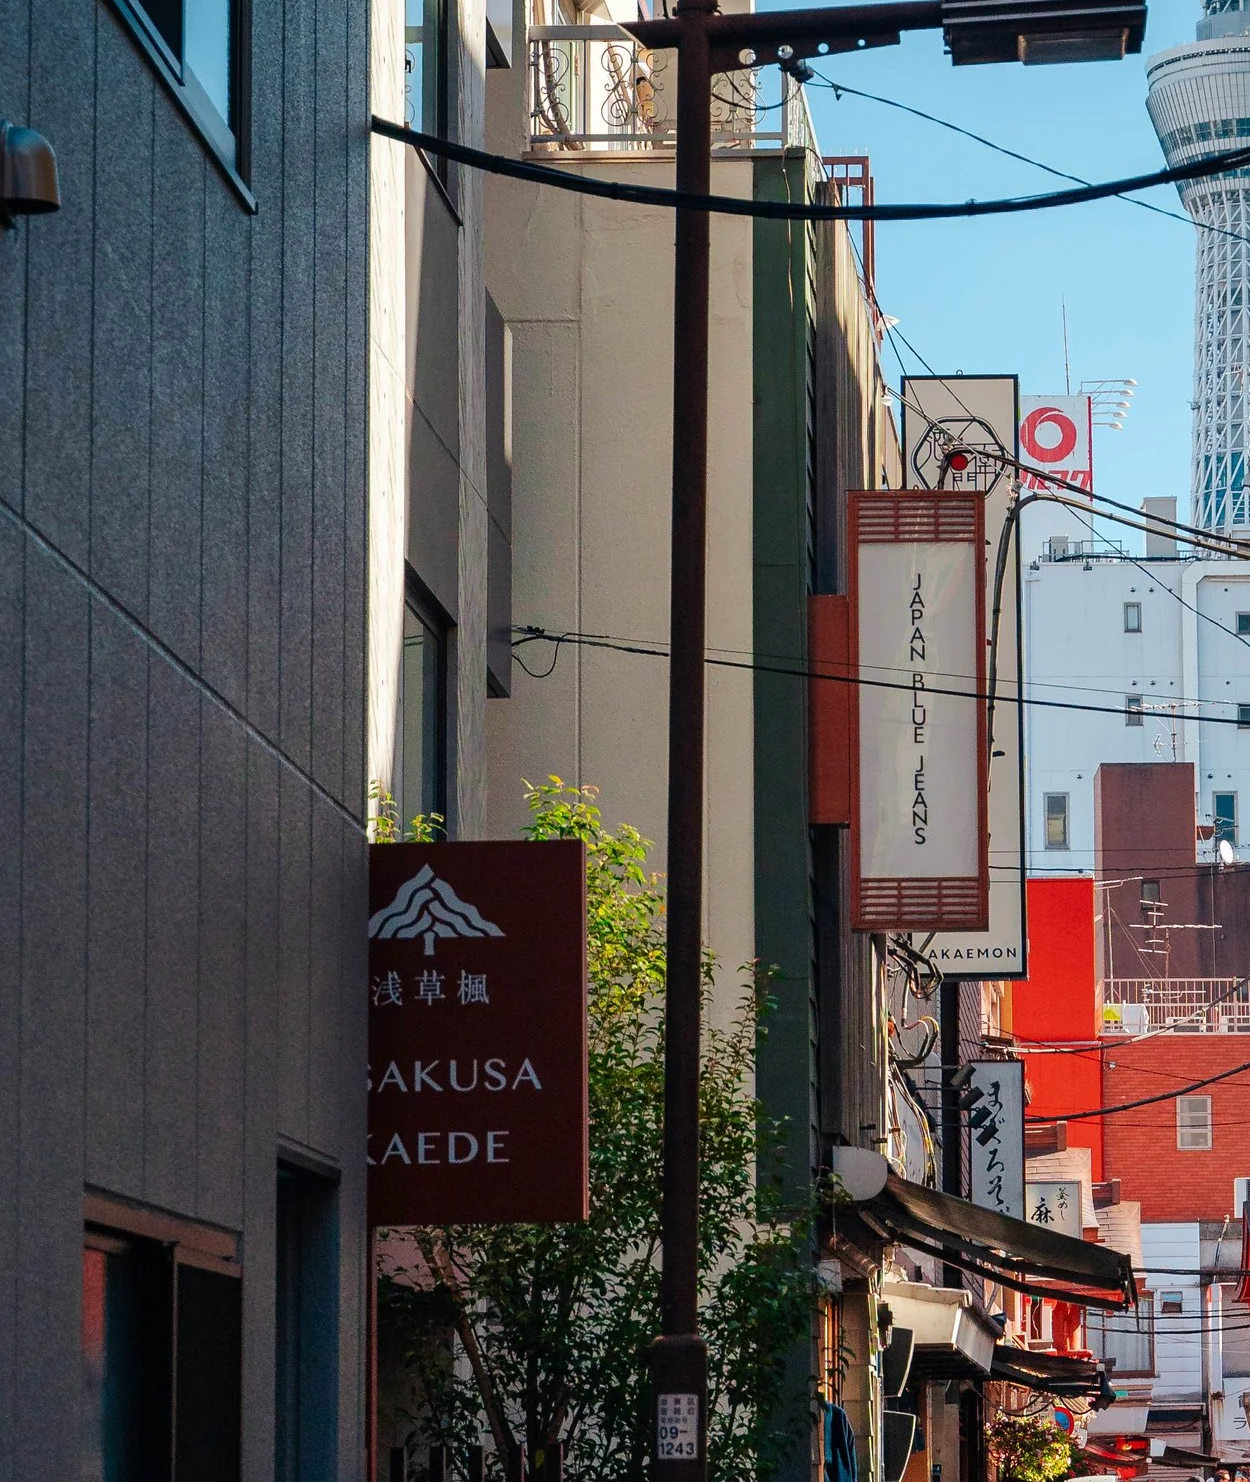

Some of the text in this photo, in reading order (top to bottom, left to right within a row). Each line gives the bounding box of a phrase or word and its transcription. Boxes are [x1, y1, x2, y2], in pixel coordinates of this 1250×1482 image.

[909, 572, 929, 846] JAPAN BLUE JEANS
[372, 969, 491, 1006] 浅草楓
[1031, 1197, 1055, 1224] 麻
[660, 1442, 695, 1456] 1243
